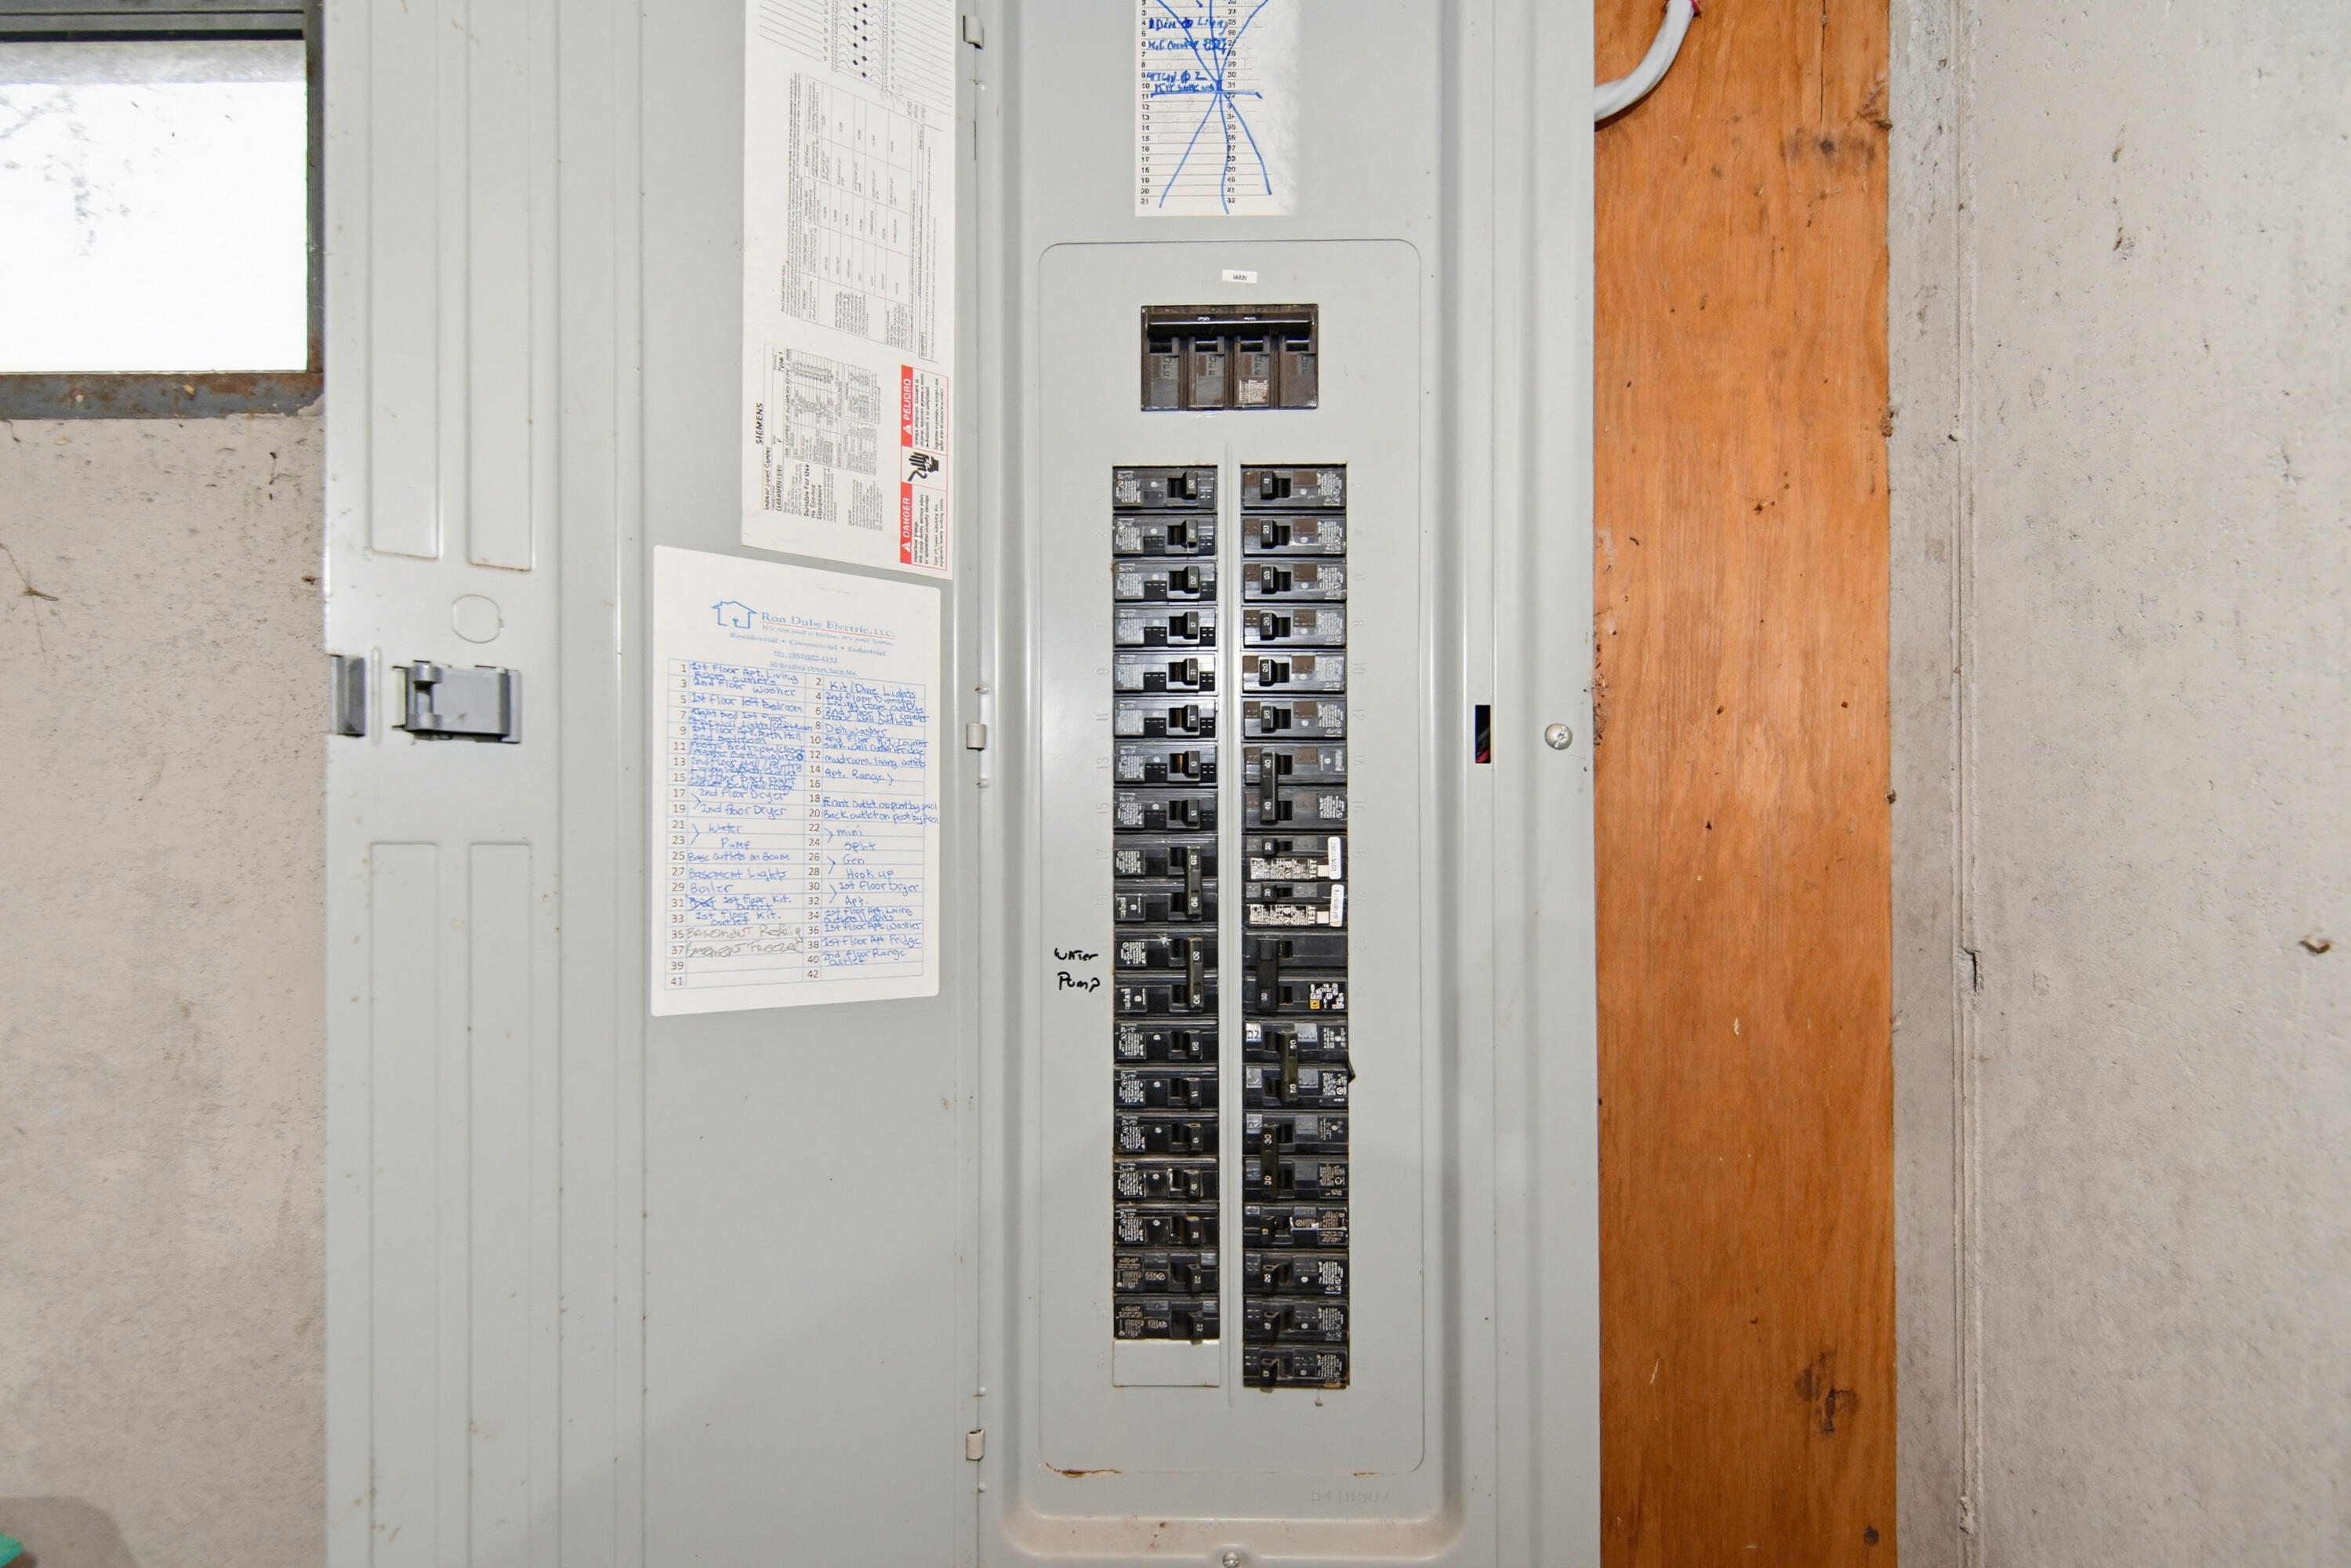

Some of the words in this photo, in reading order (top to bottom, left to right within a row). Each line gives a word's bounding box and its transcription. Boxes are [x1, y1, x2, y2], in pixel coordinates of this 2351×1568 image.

[1263, 525, 1269, 533] 20
[761, 612, 785, 623] Ron
[682, 664, 686, 672] 1
[680, 680, 687, 688] 3
[680, 695, 686, 704] 5
[680, 727, 686, 735] 9
[674, 742, 686, 750] 11
[674, 757, 686, 766] 13
[673, 773, 686, 781] 15
[673, 789, 685, 797] 17
[809, 794, 820, 803] 18
[673, 805, 685, 813] 19
[700, 804, 721, 813] 2nd
[1264, 802, 1271, 810] 40
[672, 820, 685, 829] 21
[672, 836, 685, 845] 23
[672, 851, 685, 860] 25
[843, 854, 865, 865] Gen
[672, 867, 685, 876] 27
[672, 883, 685, 891] 29
[690, 881, 734, 894] Boiler
[672, 899, 684, 907] 31
[672, 914, 684, 923] 33
[757, 911, 781, 919] Kit.
[808, 911, 819, 920] 34
[671, 930, 684, 939] 35
[808, 926, 819, 934] 36
[671, 946, 684, 954] 37
[671, 961, 684, 970] 39
[807, 970, 818, 978] 42
[671, 977, 682, 985] 41
[1058, 971, 1101, 993] Pump
[1264, 1134, 1272, 1144] 30
